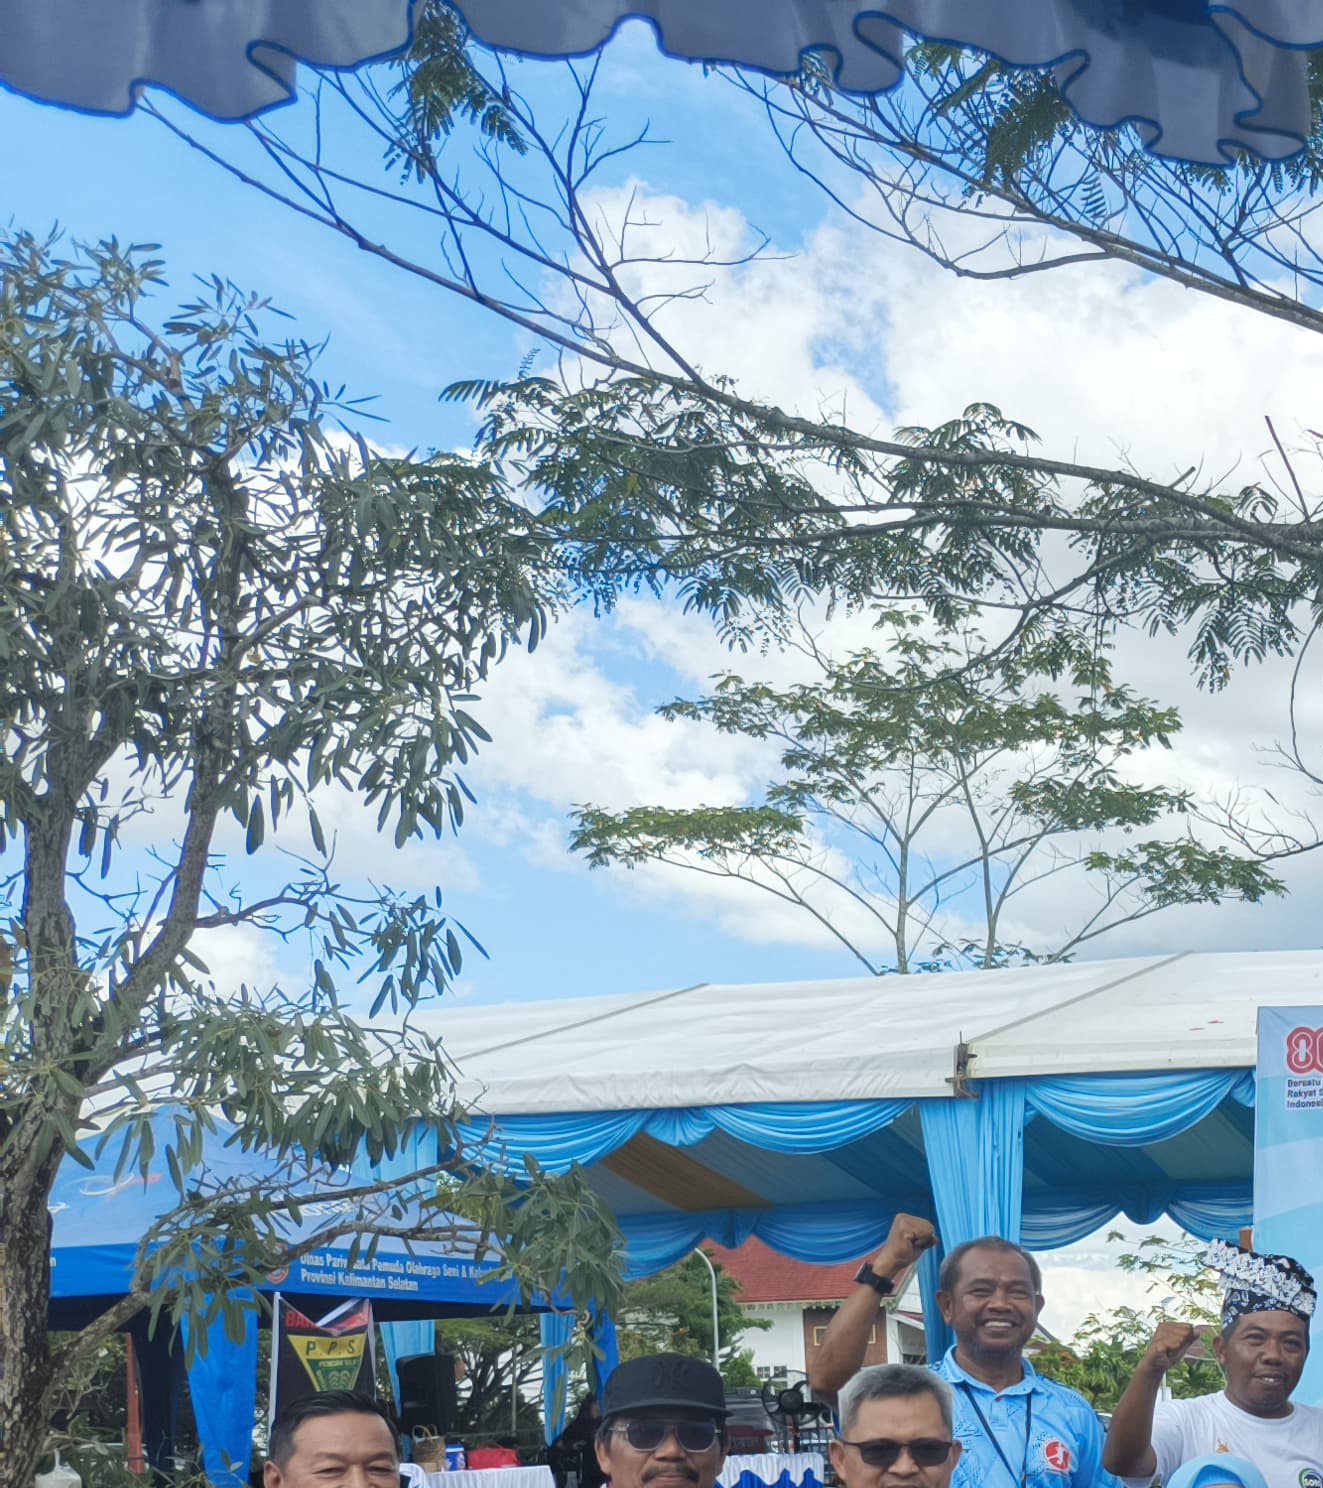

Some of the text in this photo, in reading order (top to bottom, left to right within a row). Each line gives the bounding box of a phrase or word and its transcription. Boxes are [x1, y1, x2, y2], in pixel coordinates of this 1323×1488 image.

[301, 1268, 419, 1292] Provinsi Kalimantan Selatan
